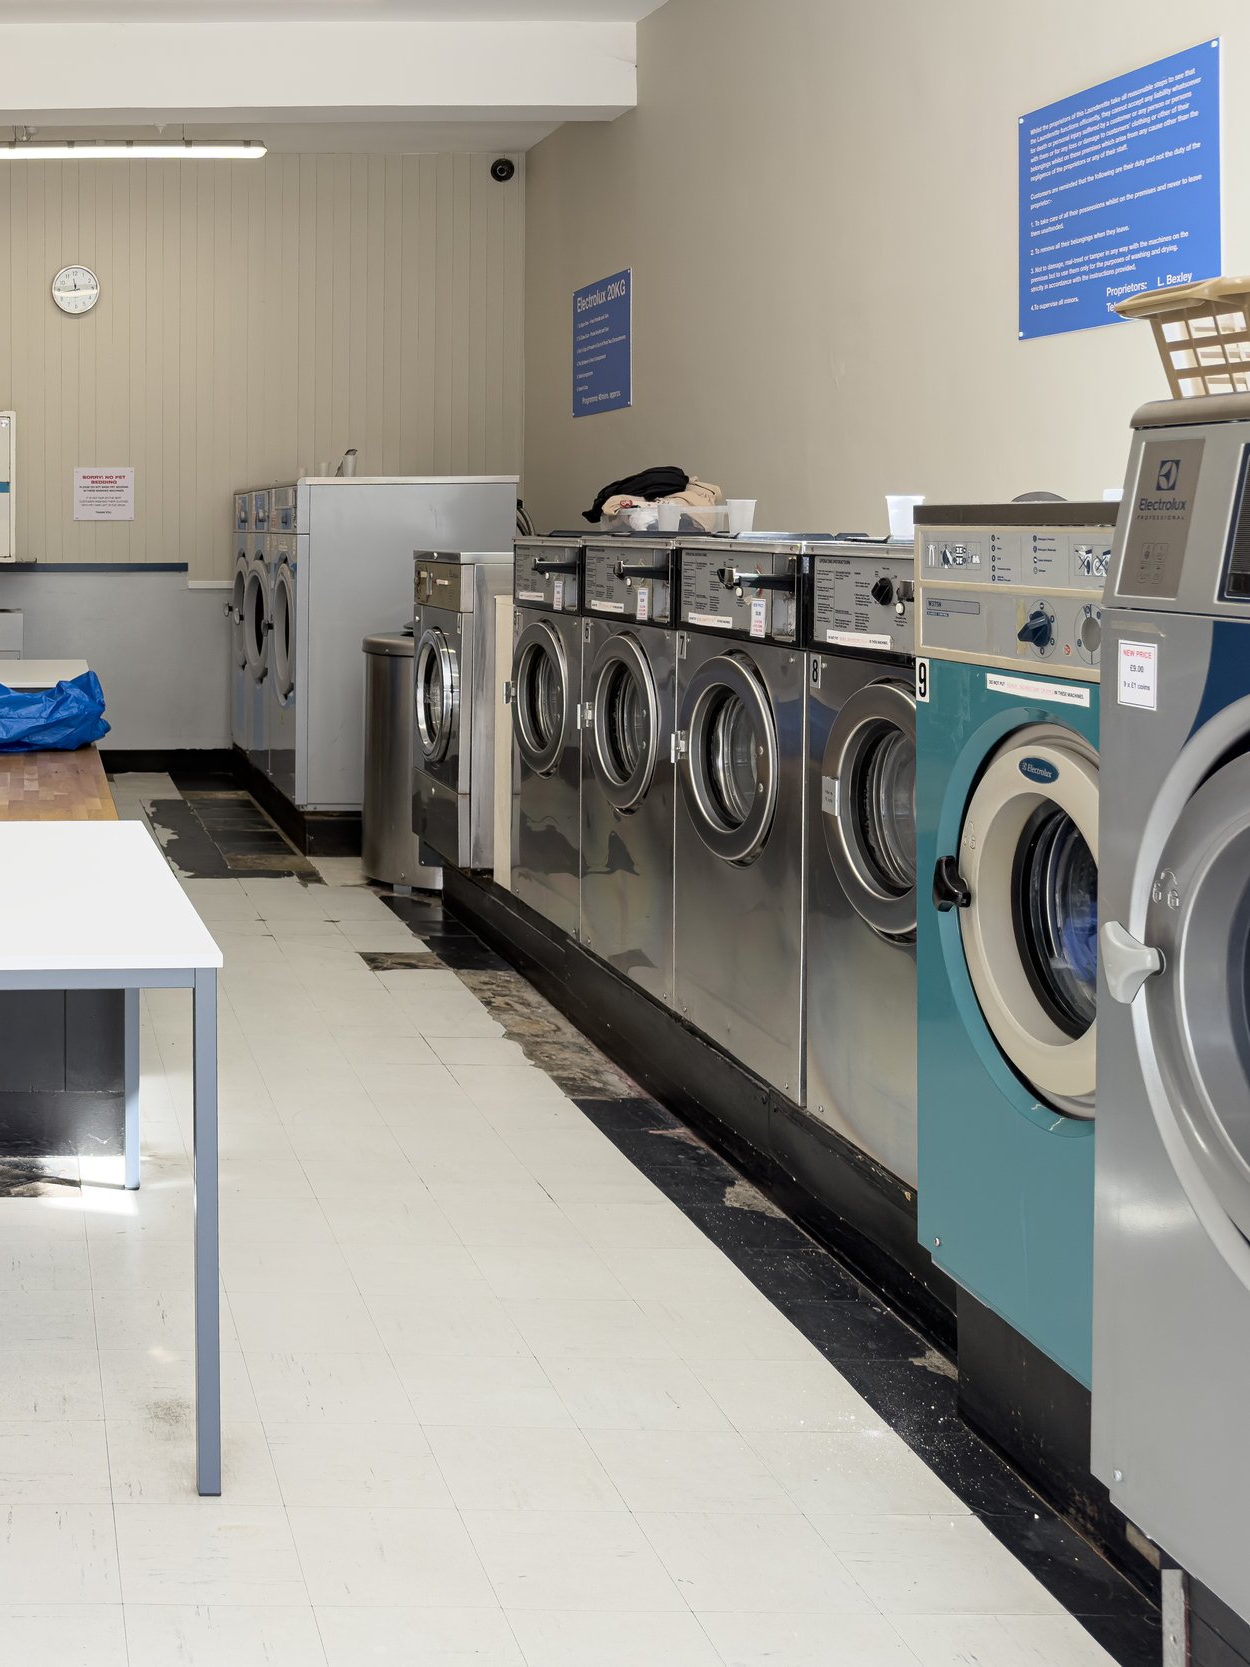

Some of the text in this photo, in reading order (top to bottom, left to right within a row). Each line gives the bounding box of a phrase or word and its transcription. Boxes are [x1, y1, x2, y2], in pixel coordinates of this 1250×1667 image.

[1127, 82, 1153, 98] reasonable
[1154, 77, 1167, 89] steps
[1174, 72, 1183, 80] see
[1184, 66, 1194, 76] that
[1127, 97, 1143, 110] accept
[1144, 94, 1153, 104] any
[1153, 86, 1171, 100] liability
[1171, 75, 1200, 92] whatsoever
[1131, 115, 1150, 128] clothing
[1157, 108, 1170, 118] other
[1177, 101, 1188, 111] their
[1138, 107, 1146, 116] any
[1147, 101, 1164, 113] person
[1171, 91, 1191, 104] persons
[1138, 127, 1147, 136] any
[1148, 122, 1162, 132] cause
[1163, 116, 1176, 127] other
[1177, 112, 1189, 122] than
[1189, 109, 1198, 118] the
[1134, 158, 1144, 168] duty
[1145, 154, 1155, 164] and
[1155, 152, 1164, 160] not
[1164, 149, 1172, 158] the
[1173, 145, 1184, 156] duty
[1192, 140, 1200, 149] the
[1134, 186, 1156, 199] premises
[1156, 182, 1166, 191] and
[1166, 180, 1180, 189] never
[1188, 172, 1201, 183] leave
[1148, 234, 1171, 245] machines
[1180, 230, 1188, 238] the
[1130, 249, 1150, 261] washing
[1151, 246, 1160, 255] and
[577, 279, 626, 312] Electrolux 20KG
[1106, 272, 1192, 296] Proprietors: L. Bexley
[1139, 498, 1186, 511] Electrolux
[680, 636, 684, 655] 7
[1136, 651, 1152, 659] PRICE
[812, 660, 818, 682] 8
[918, 662, 926, 697] 9
[1130, 664, 1144, 672] £9.00
[1027, 764, 1052, 778] Electrolux
